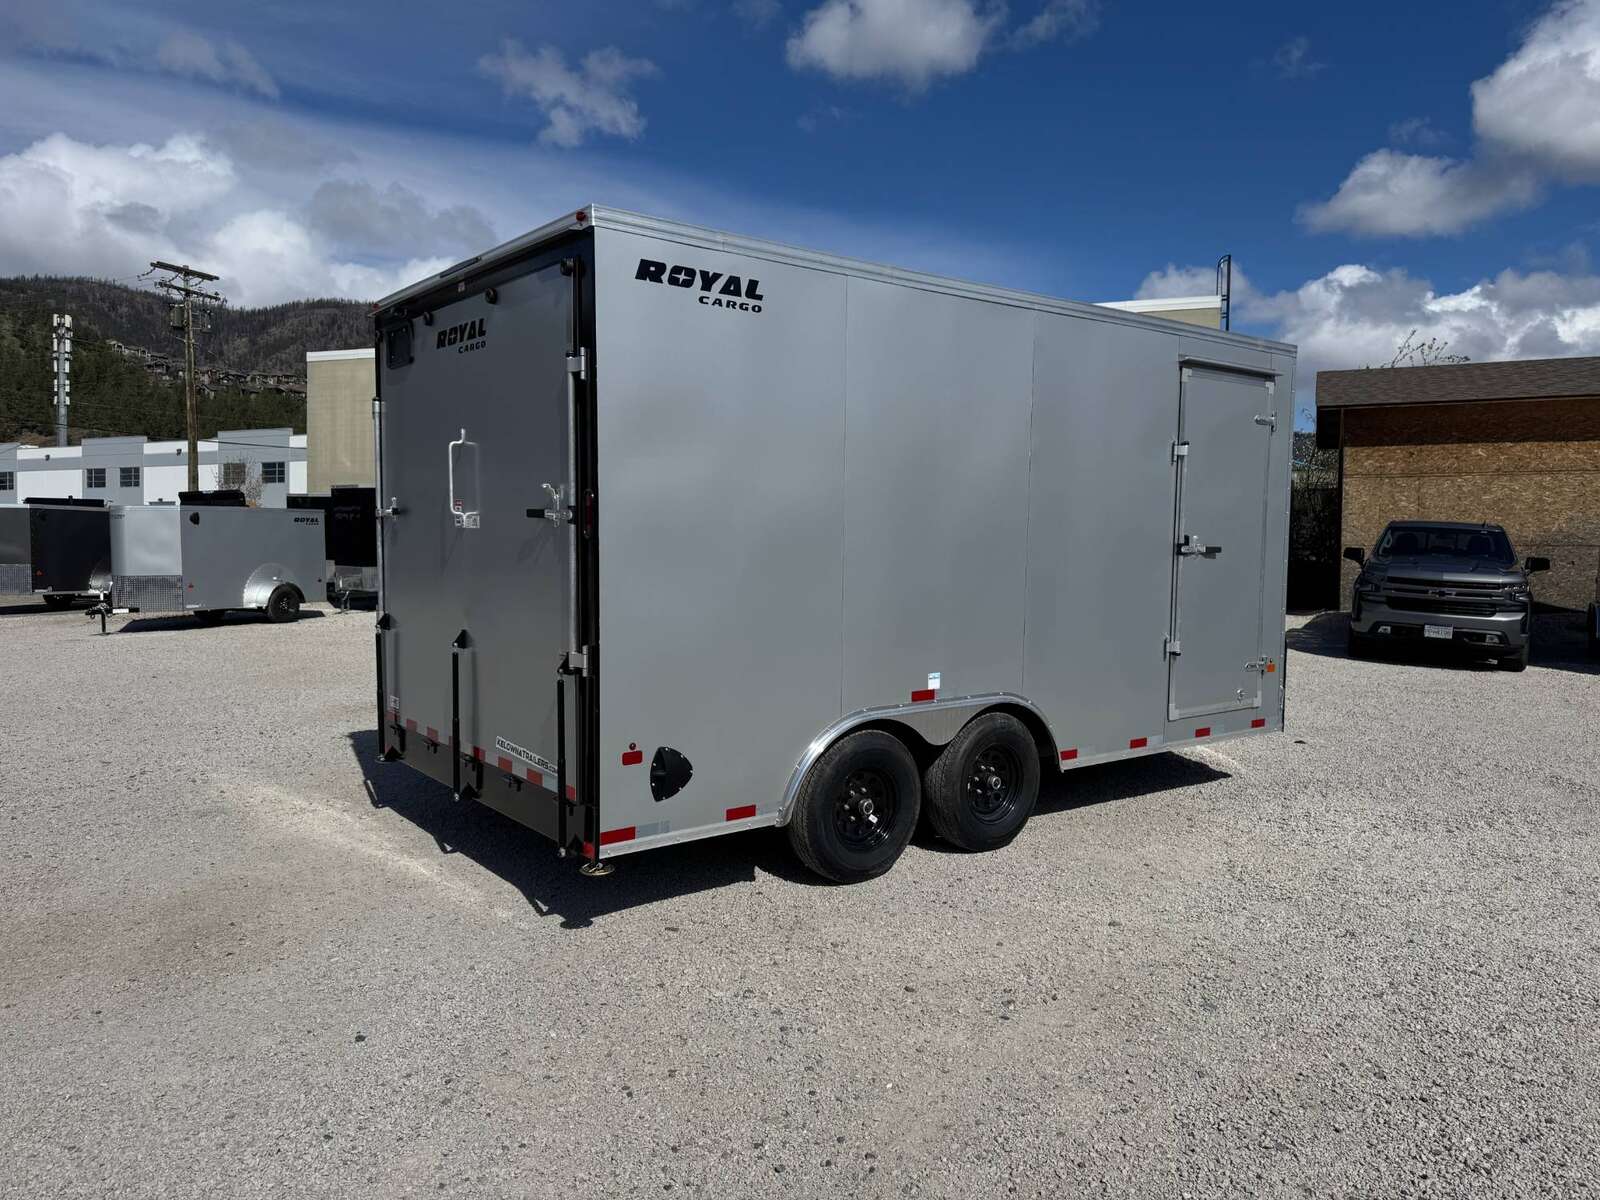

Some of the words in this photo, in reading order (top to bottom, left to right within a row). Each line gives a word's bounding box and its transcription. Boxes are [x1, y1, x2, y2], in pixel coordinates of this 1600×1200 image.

[635, 258, 764, 301] ROYAL
[698, 296, 763, 313] CARGO
[437, 318, 486, 349] ROYAL
[458, 341, 486, 354] CARGO
